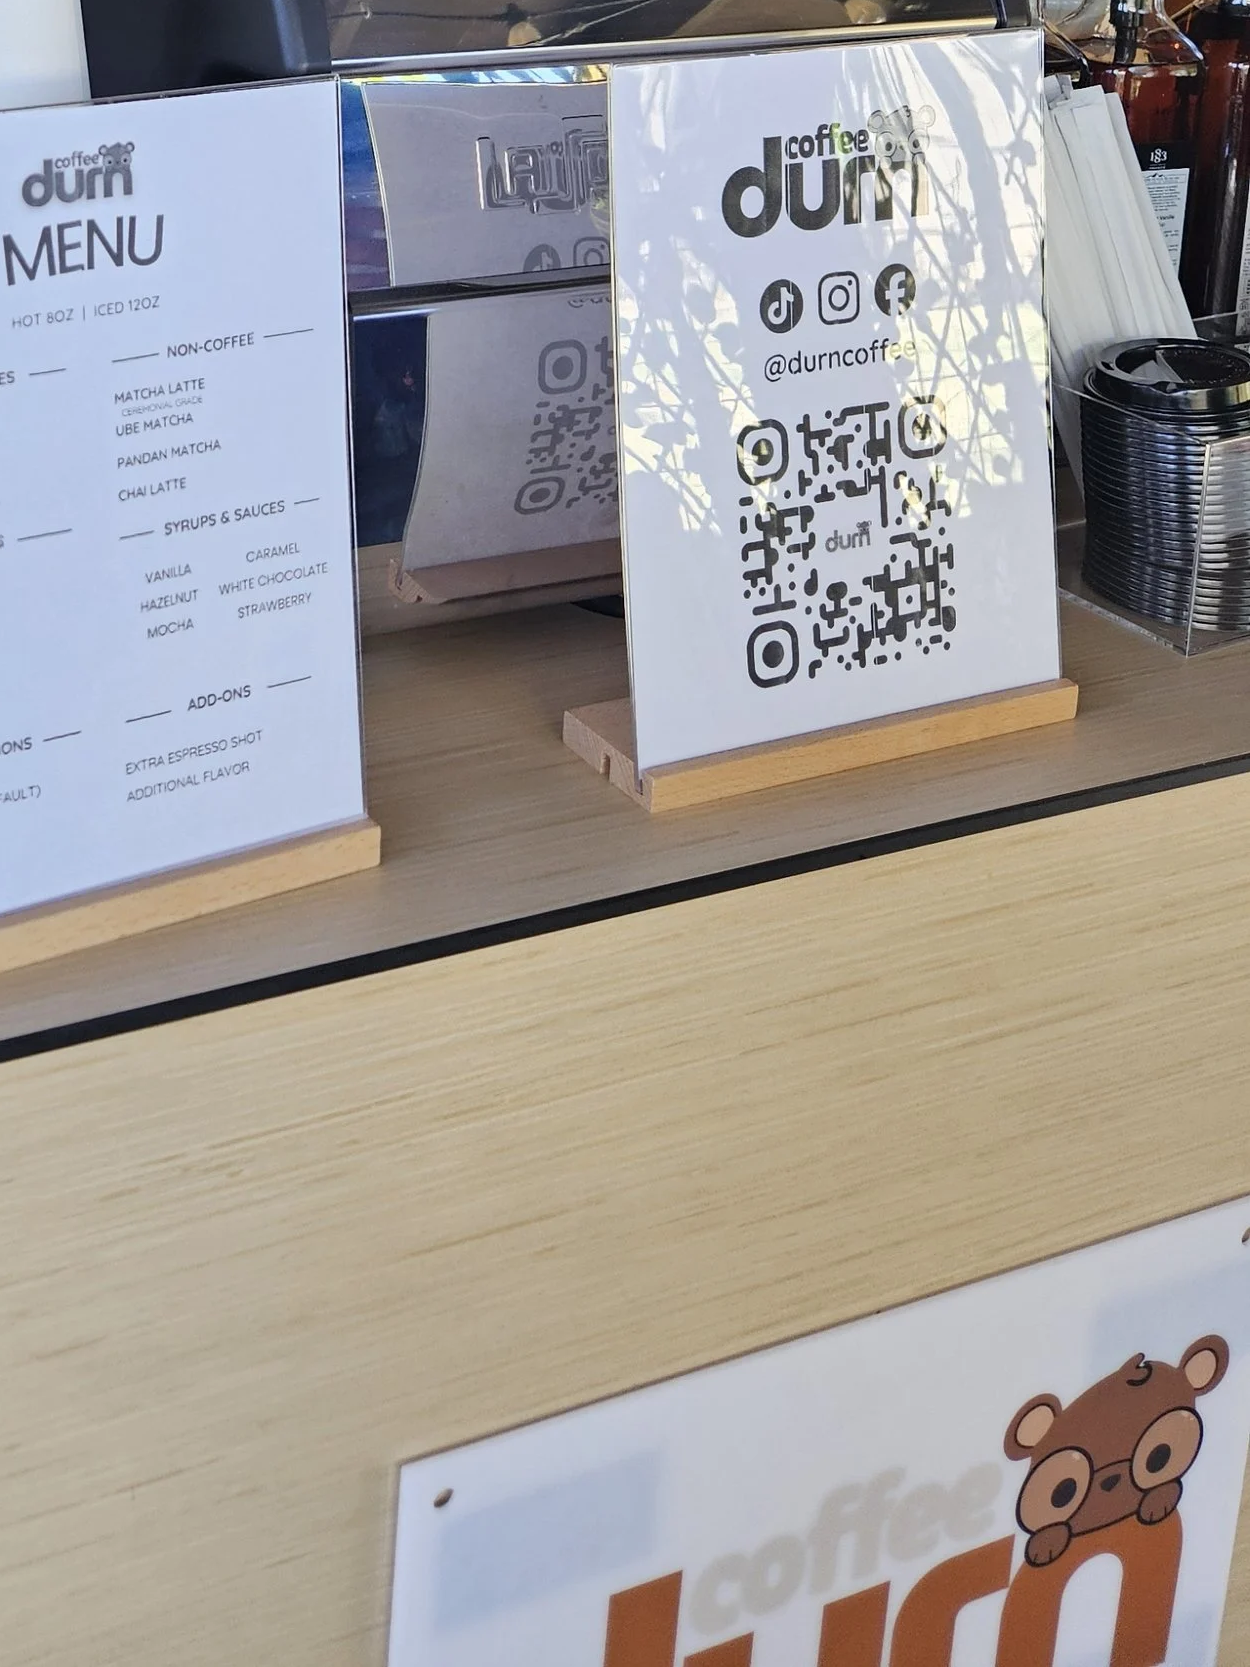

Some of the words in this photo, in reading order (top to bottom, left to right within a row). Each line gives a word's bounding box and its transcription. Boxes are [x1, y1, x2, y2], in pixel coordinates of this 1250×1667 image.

[785, 122, 870, 160] coffee
[55, 150, 100, 169] coffee
[21, 157, 133, 207] durn
[720, 134, 930, 238] durn
[2, 214, 164, 286] MENU
[12, 313, 42, 329] HOT
[93, 301, 124, 317] ICED
[166, 332, 255, 358] NON-COFFEE
[764, 337, 916, 383] @durncoffee
[114, 382, 165, 404] MATCHA
[168, 377, 206, 394] LATTE
[115, 421, 140, 437] UBE
[143, 412, 194, 432] MATCHA
[117, 448, 168, 469] PANDAN
[171, 439, 222, 458] MATCHA
[118, 484, 147, 502] CHAI
[150, 476, 187, 496] LATTE
[163, 513, 217, 536] SYRUPS
[220, 510, 231, 524] &
[234, 499, 286, 522] SAUCES
[245, 542, 301, 564] CARAMEL
[144, 563, 192, 584] VANILLA
[218, 577, 255, 596] WHITE
[257, 562, 329, 587] CHOCOLATE
[140, 588, 199, 613] HAZELNUT
[237, 592, 312, 619] STRAWBERRY
[146, 618, 194, 639] MOCHA
[187, 684, 252, 712] ADD-ONS
[125, 754, 166, 776] EXTRA
[167, 738, 228, 766] ESPRESSO
[230, 729, 263, 749] SHOT
[126, 773, 200, 802] ADDITIONAL
[203, 760, 251, 783] FLAVOR
[688, 1460, 1007, 1637] coffee
